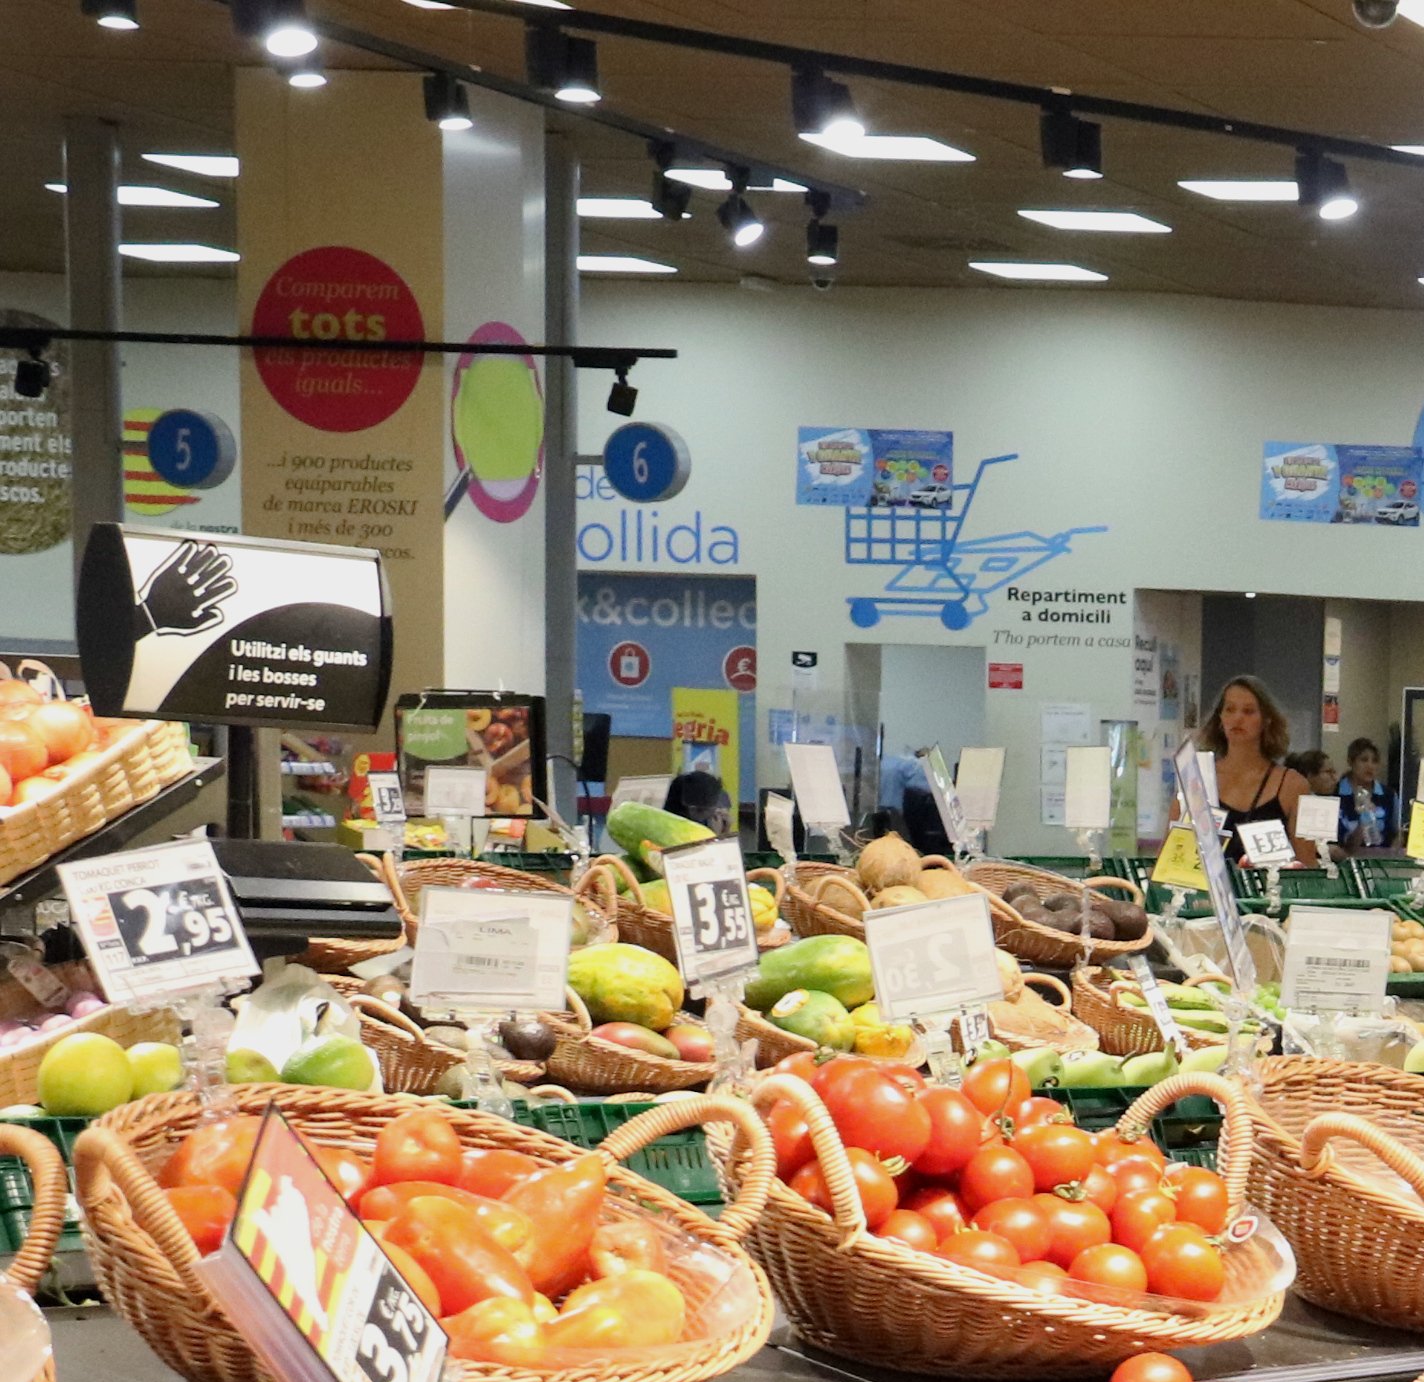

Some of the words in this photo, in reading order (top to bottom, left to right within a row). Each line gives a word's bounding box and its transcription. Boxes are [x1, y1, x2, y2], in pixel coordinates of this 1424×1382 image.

[276, 277, 399, 301] Comparem
[289, 308, 387, 341] tots
[175, 427, 192, 470] 5
[329, 457, 413, 477] productes
[632, 442, 649, 484] 6
[285, 476, 395, 496] equiparables
[263, 496, 282, 512] de
[288, 499, 343, 513] marca
[347, 500, 418, 517] EROSKI
[297, 521, 331, 536] més
[336, 521, 355, 535] de
[359, 524, 393, 541] 300
[577, 509, 740, 565] ollida
[1008, 587, 1127, 605] Repartiment
[1022, 611, 1032, 622] a
[1039, 609, 1111, 624] domicili
[1026, 633, 1080, 649] portem
[1085, 638, 1094, 648] a
[1097, 638, 1132, 648] casa
[231, 639, 286, 660] Utilitzi
[288, 644, 312, 662] els
[313, 648, 367, 667] guants
[237, 666, 260, 682] les
[262, 666, 318, 687] bosses
[226, 691, 255, 709] per
[256, 691, 326, 711] servir-se
[122, 888, 233, 956] 2,95
[694, 883, 748, 949] 3,55
